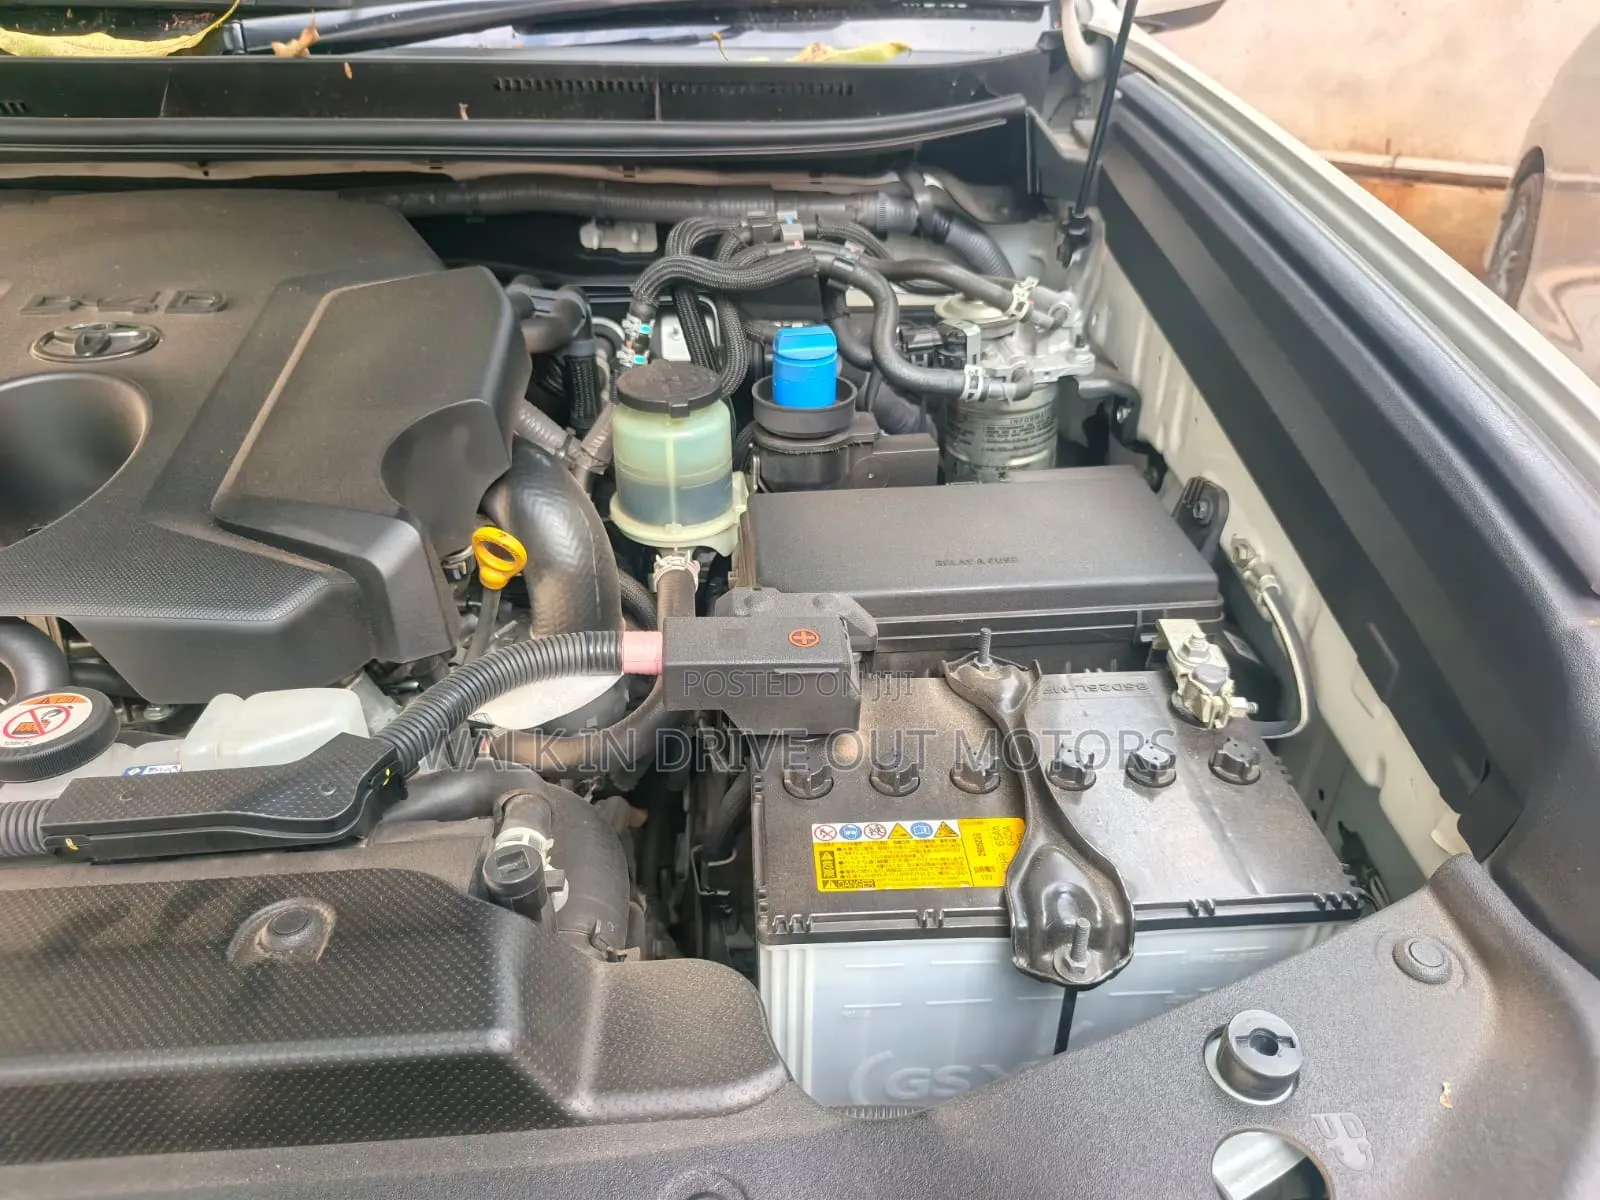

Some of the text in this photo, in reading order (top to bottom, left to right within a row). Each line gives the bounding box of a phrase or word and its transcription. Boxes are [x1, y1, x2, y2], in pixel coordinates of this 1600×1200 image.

[935, 559, 974, 567] RELAY
[836, 879, 876, 889] DANGER
[885, 1065, 972, 1100] GS
